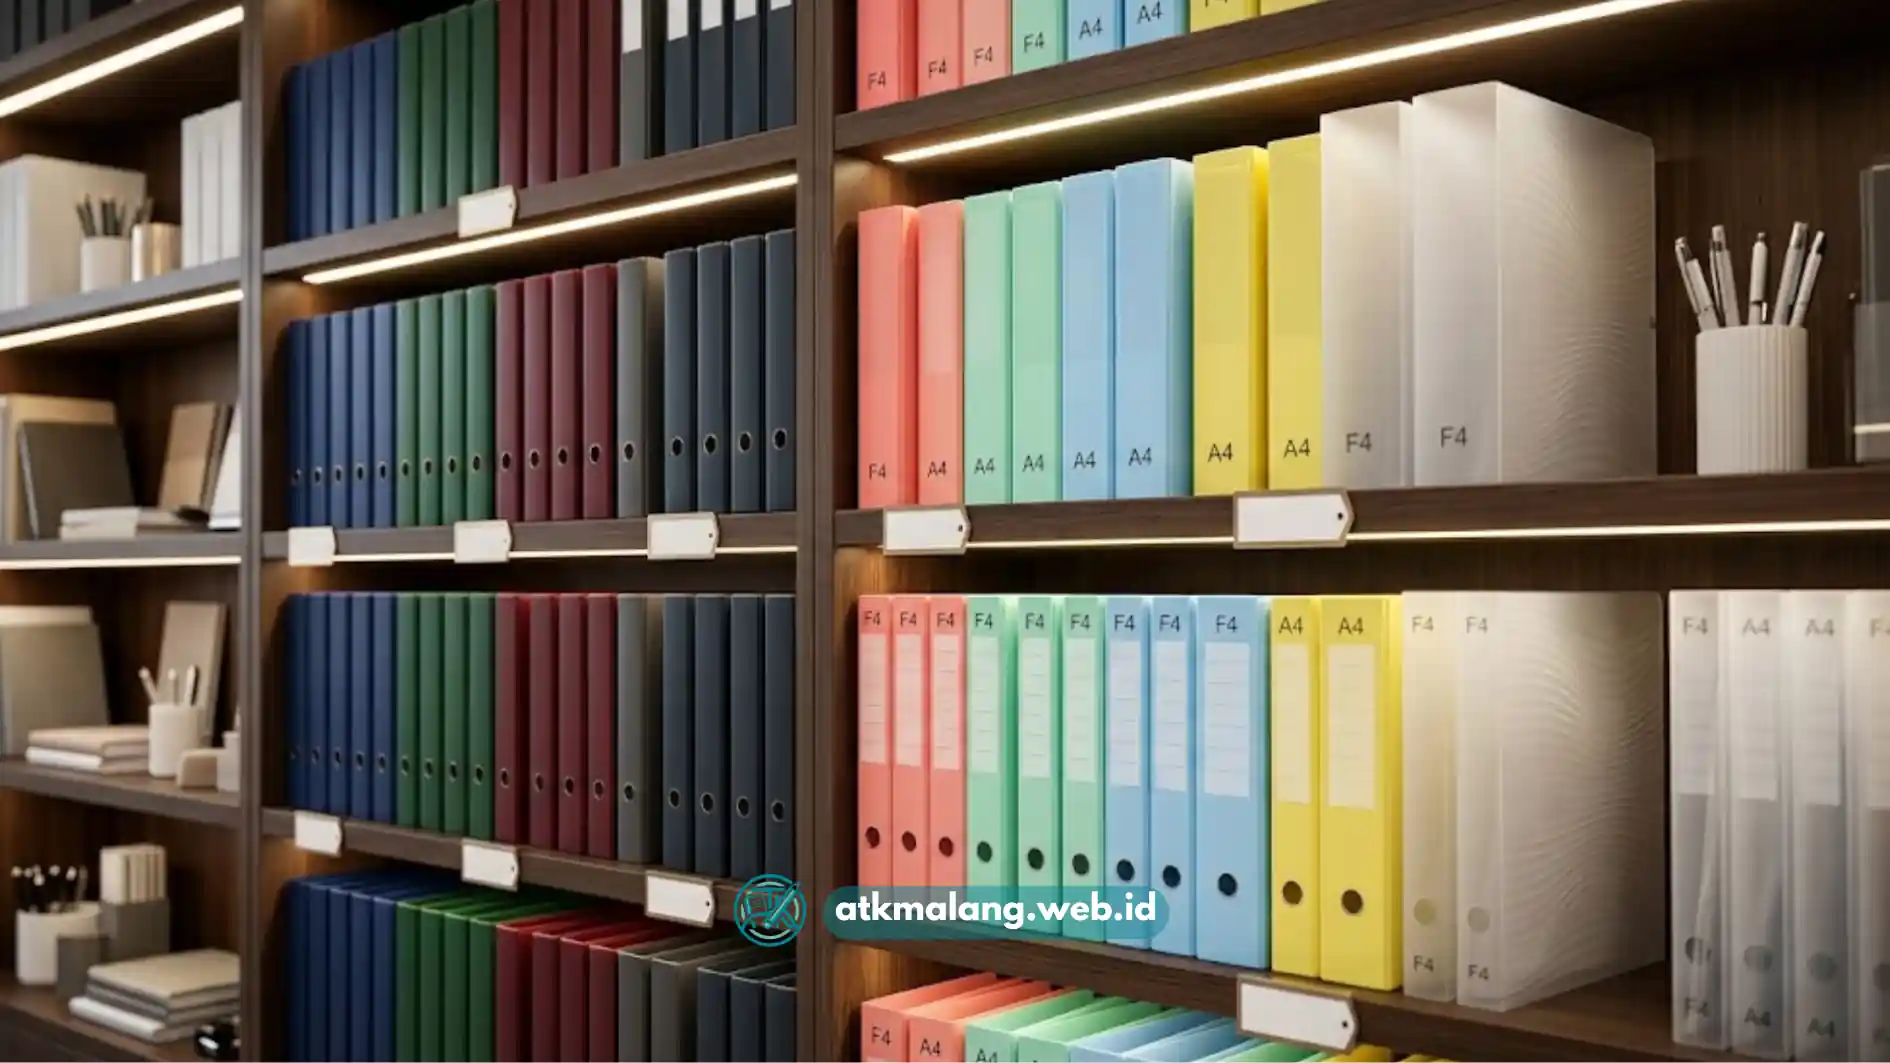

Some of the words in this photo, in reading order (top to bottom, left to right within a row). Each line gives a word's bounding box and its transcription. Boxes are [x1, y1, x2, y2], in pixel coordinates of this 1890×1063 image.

[1137, 2, 1163, 24] A4
[1078, 17, 1104, 40] A4
[1022, 32, 1046, 53] F4
[973, 46, 994, 66] F4
[927, 60, 948, 79] F4
[867, 71, 887, 90] F4
[1345, 432, 1373, 453] F4
[1440, 426, 1468, 449] F4
[1127, 447, 1153, 467] A4
[1207, 442, 1234, 464] A4
[1283, 437, 1311, 460] A4
[926, 461, 948, 479] A4
[973, 457, 996, 475] A4
[1022, 454, 1045, 473] A4
[1073, 451, 1097, 471] A4
[868, 462, 887, 480] F4
[863, 610, 882, 627] F4
[899, 611, 918, 628] F4
[936, 611, 956, 628] F4
[974, 612, 994, 630] F4
[1025, 612, 1046, 630] F4
[1070, 613, 1092, 631] F4
[1114, 614, 1136, 632] F4
[1159, 613, 1182, 633] F4
[1215, 614, 1239, 634] F4
[1279, 616, 1304, 635] A4
[1338, 616, 1364, 636] A4
[1412, 616, 1435, 634] F4
[1466, 616, 1489, 635] F4
[1683, 616, 1709, 636] F4
[1743, 618, 1770, 637] A4
[1806, 618, 1836, 638] A4
[1413, 955, 1435, 973] F4
[1467, 964, 1490, 981] F4
[871, 1026, 892, 1046] F4
[919, 1038, 942, 1057] A4
